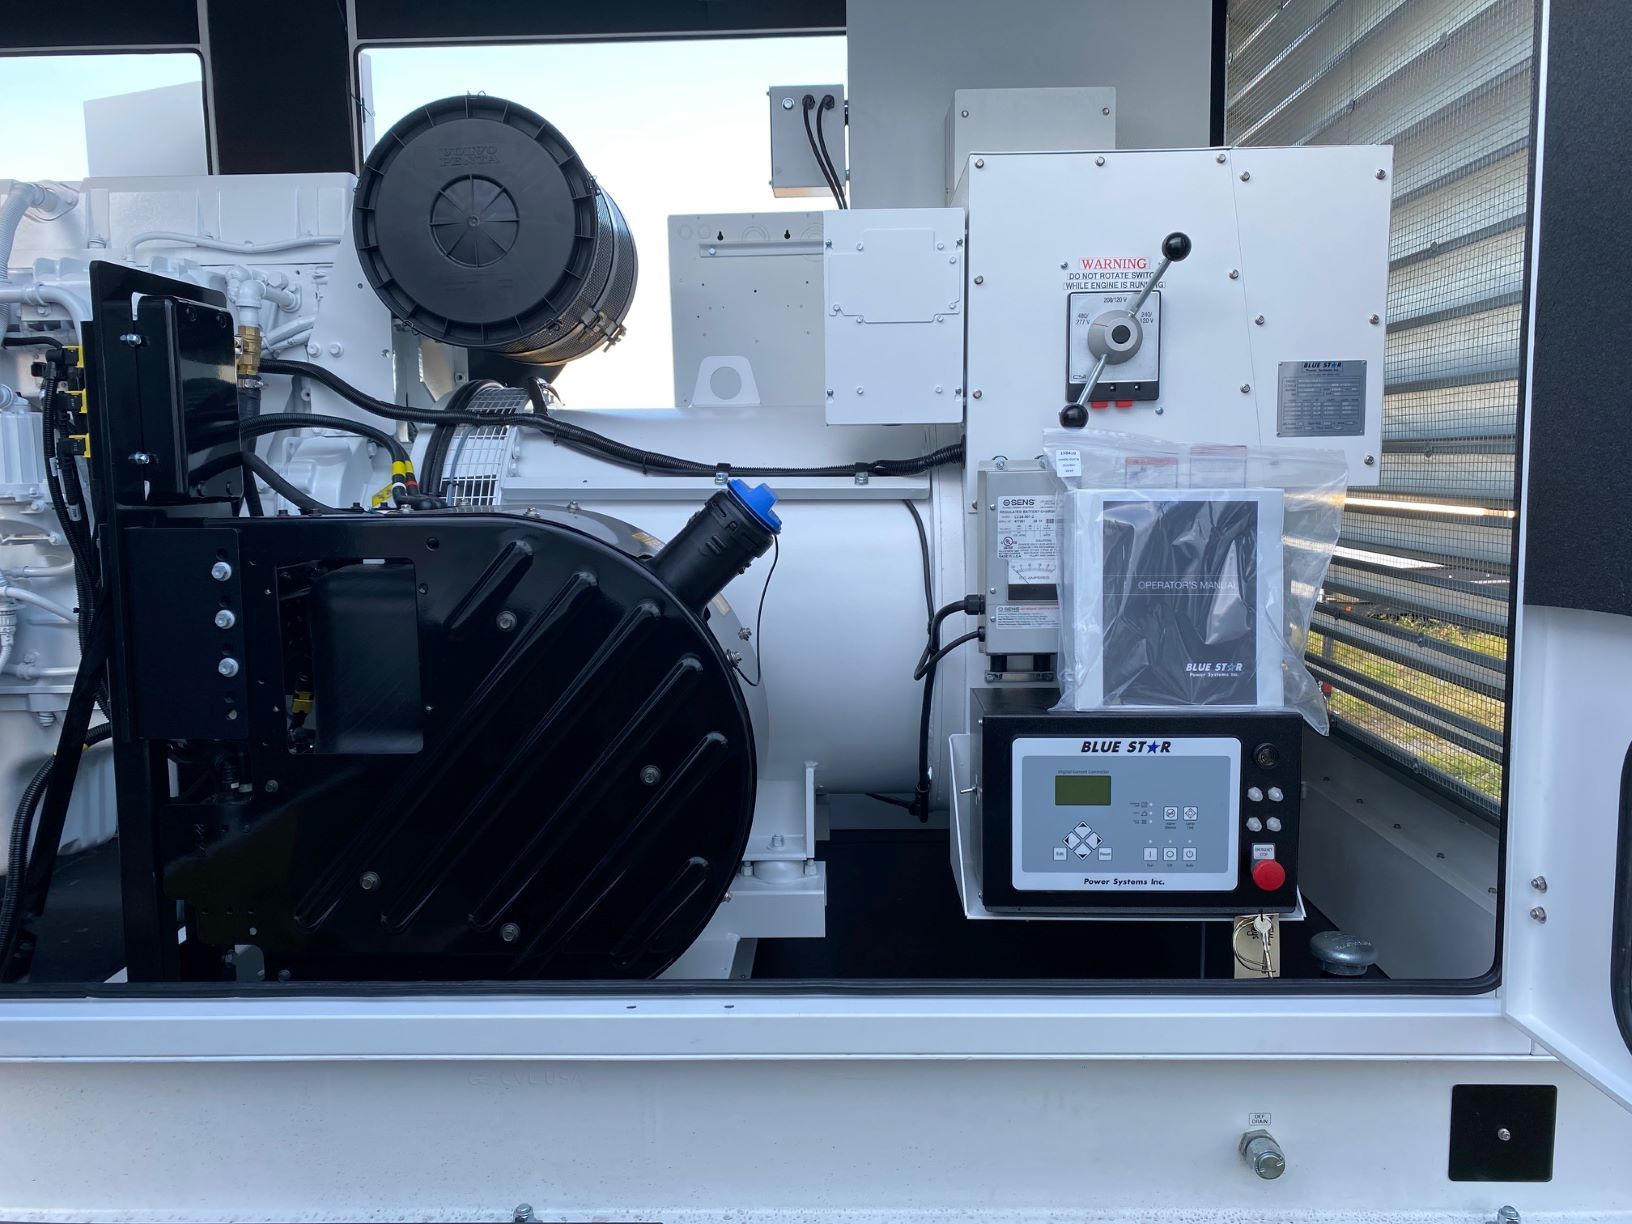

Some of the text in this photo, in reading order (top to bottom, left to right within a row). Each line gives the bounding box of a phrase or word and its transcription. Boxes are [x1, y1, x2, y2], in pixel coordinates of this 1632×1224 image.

[1082, 258, 1147, 269] WARNING
[1069, 272, 1080, 280] DO
[1082, 272, 1098, 280] NOT
[1131, 271, 1154, 279] SWITC
[1138, 581, 1198, 589] OPERATOR'S
[1186, 663, 1211, 671] BLUE
[1081, 741, 1121, 753] BLUE
